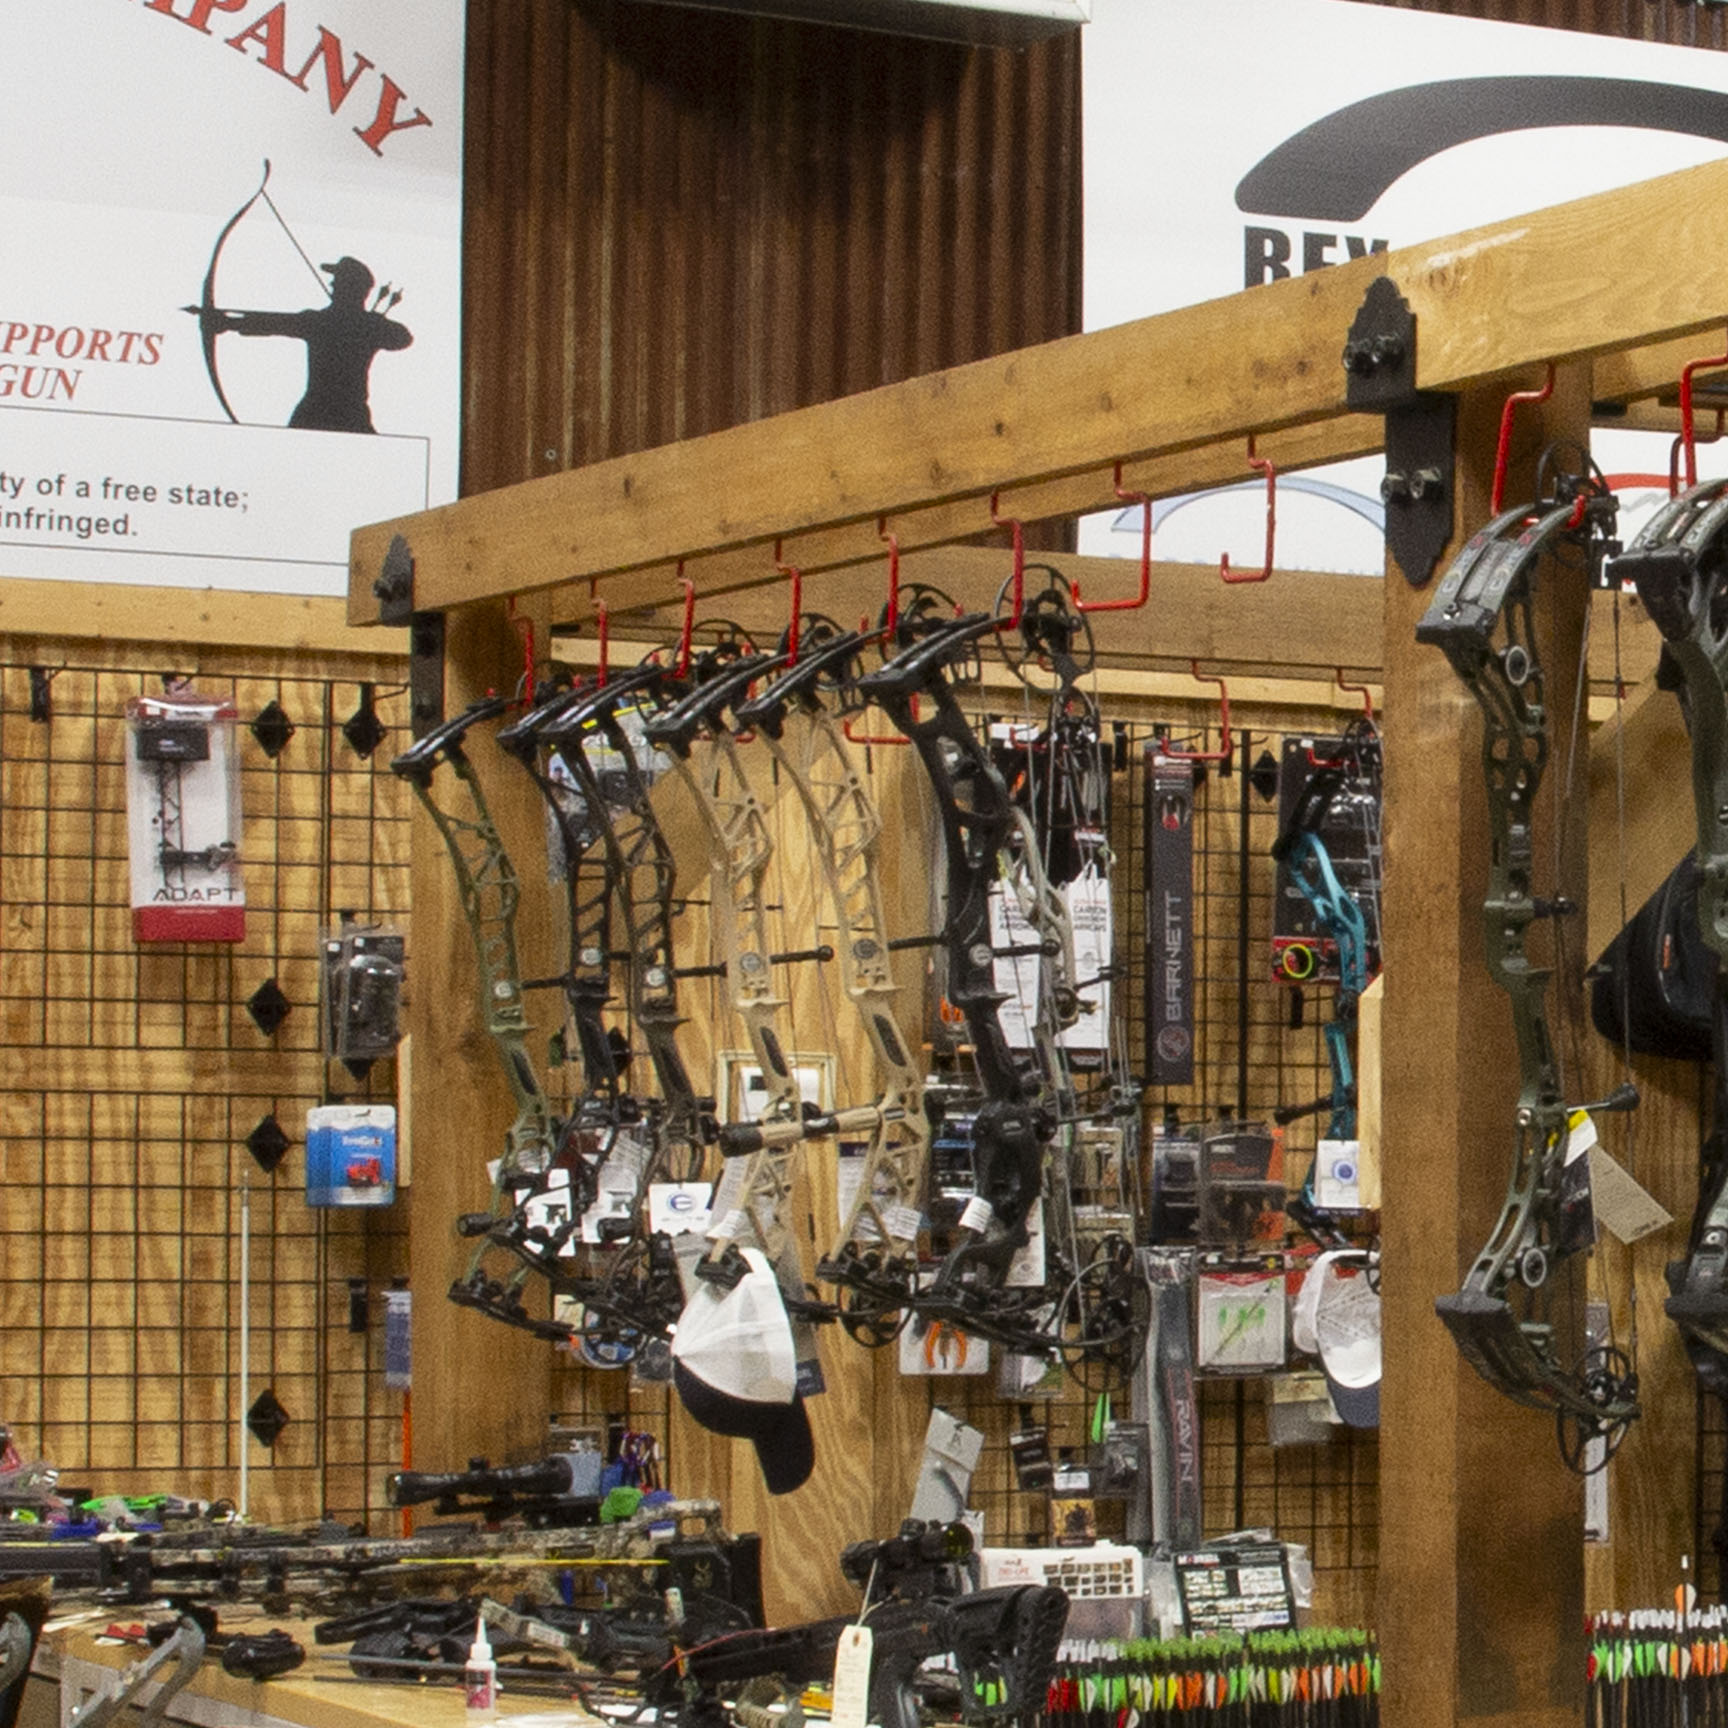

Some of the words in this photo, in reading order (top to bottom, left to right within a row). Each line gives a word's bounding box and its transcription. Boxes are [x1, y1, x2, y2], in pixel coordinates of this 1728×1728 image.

[36, 475, 66, 498] of
[75, 480, 90, 498] a
[102, 476, 158, 503] free
[168, 486, 250, 512] state;
[153, 887, 237, 901] ADAPT
[1165, 889, 1181, 1021] BARNETT
[1176, 1400, 1193, 1482] RAVIN
